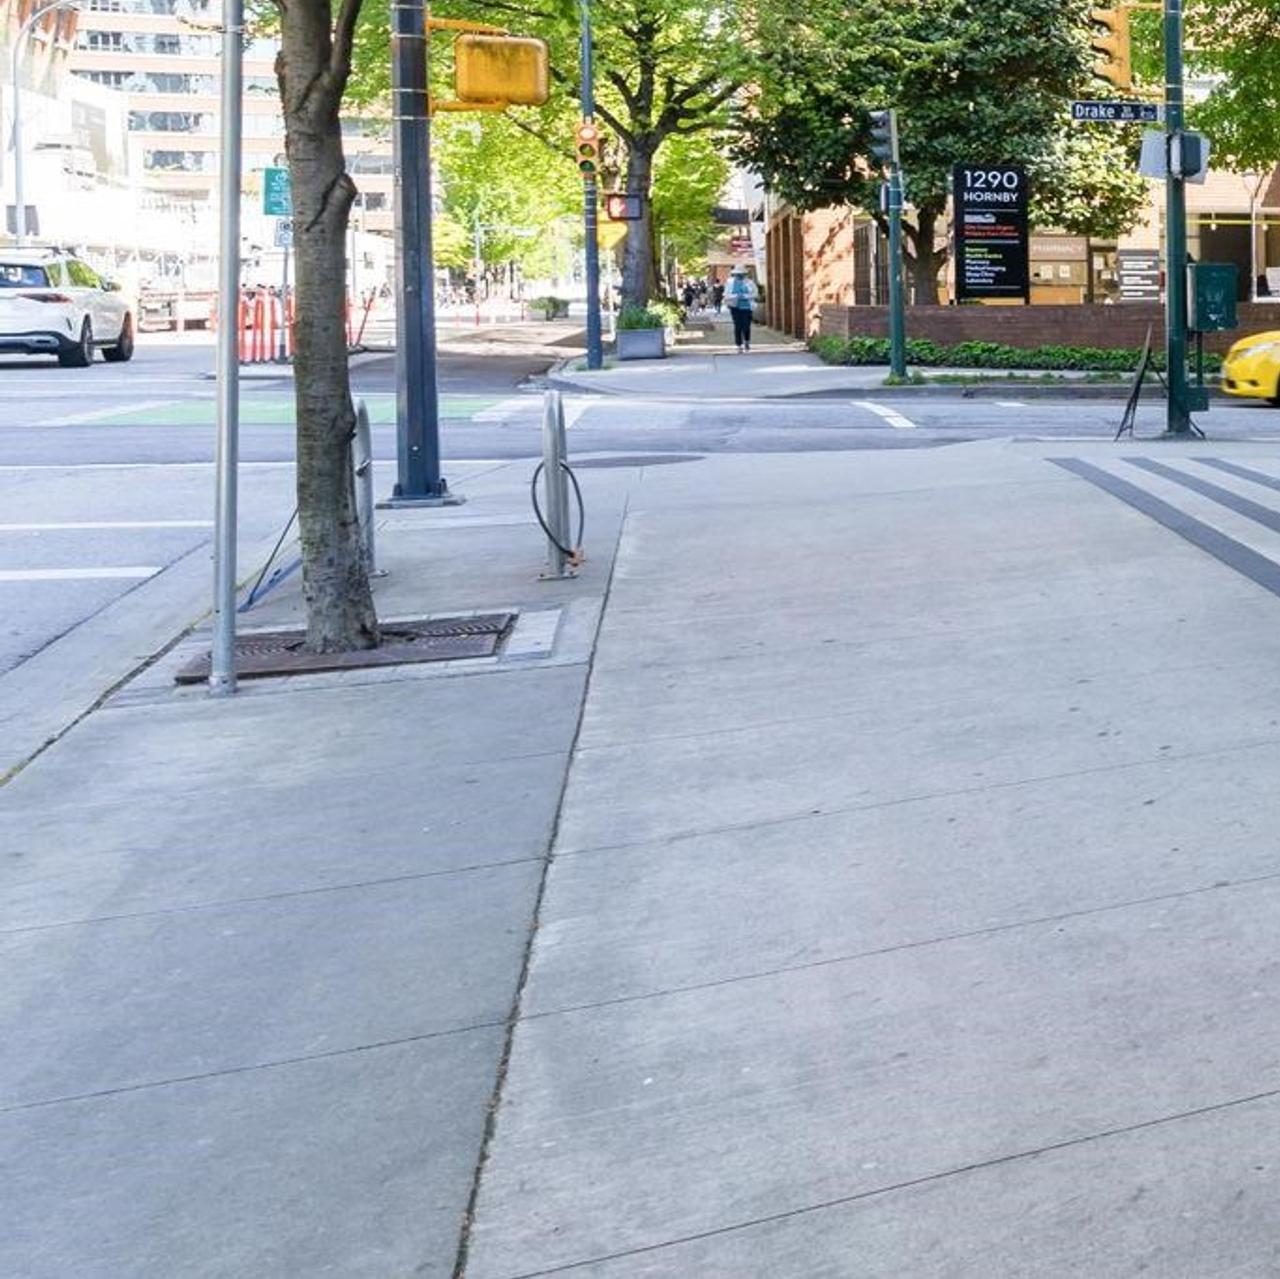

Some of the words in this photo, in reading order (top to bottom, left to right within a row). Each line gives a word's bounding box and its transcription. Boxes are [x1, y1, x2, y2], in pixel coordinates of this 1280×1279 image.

[1075, 103, 1115, 118] Drake
[963, 170, 1018, 188] 1290
[963, 192, 1018, 202] HORNBY
